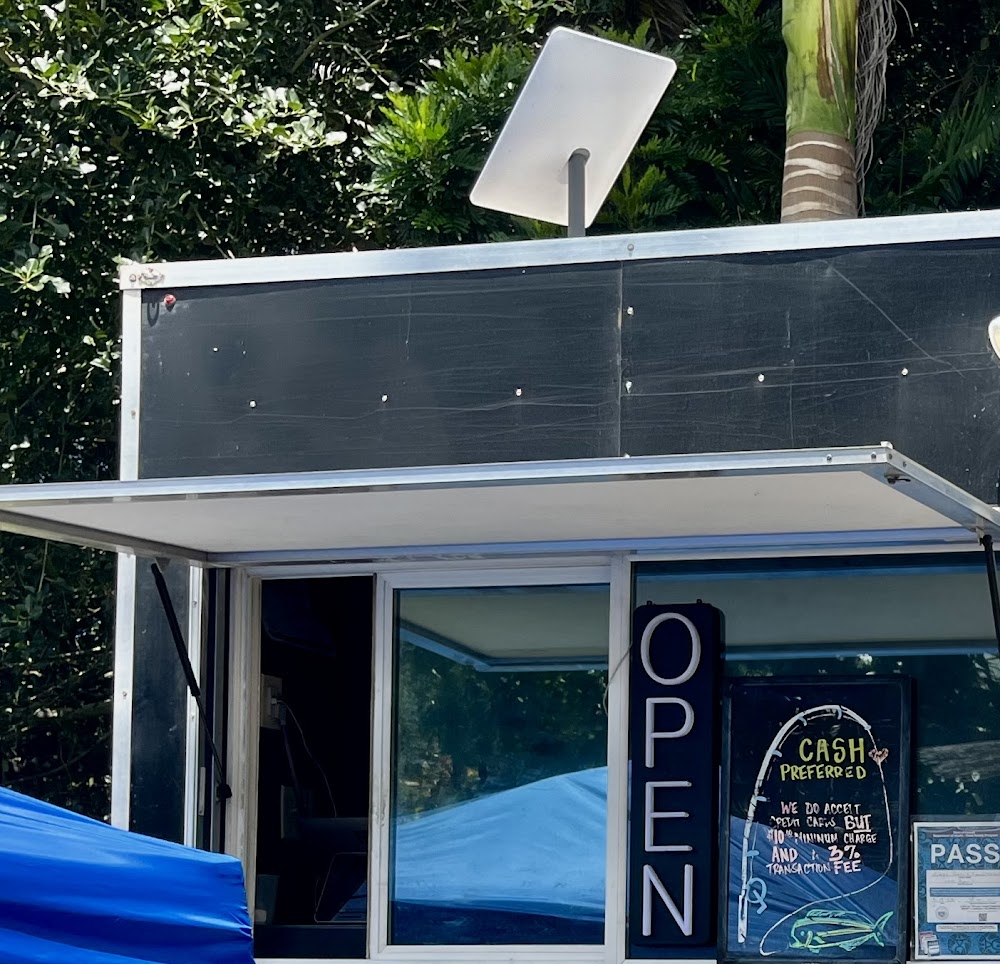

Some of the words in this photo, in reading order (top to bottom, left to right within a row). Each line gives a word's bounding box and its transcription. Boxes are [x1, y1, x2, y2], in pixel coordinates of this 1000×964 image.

[799, 738, 865, 763] CASH
[640, 612, 701, 936] OPEN
[780, 763, 866, 781] PREFERRED
[781, 801, 798, 815] WE
[805, 802, 820, 815] DO
[844, 814, 871, 830] BUT
[844, 833, 877, 844] CHARGE
[772, 846, 798, 863] AND
[828, 844, 860, 861] 3%
[931, 843, 1000, 864] PASS
[766, 862, 831, 875] TRANSACTION
[834, 859, 861, 874] FEE
